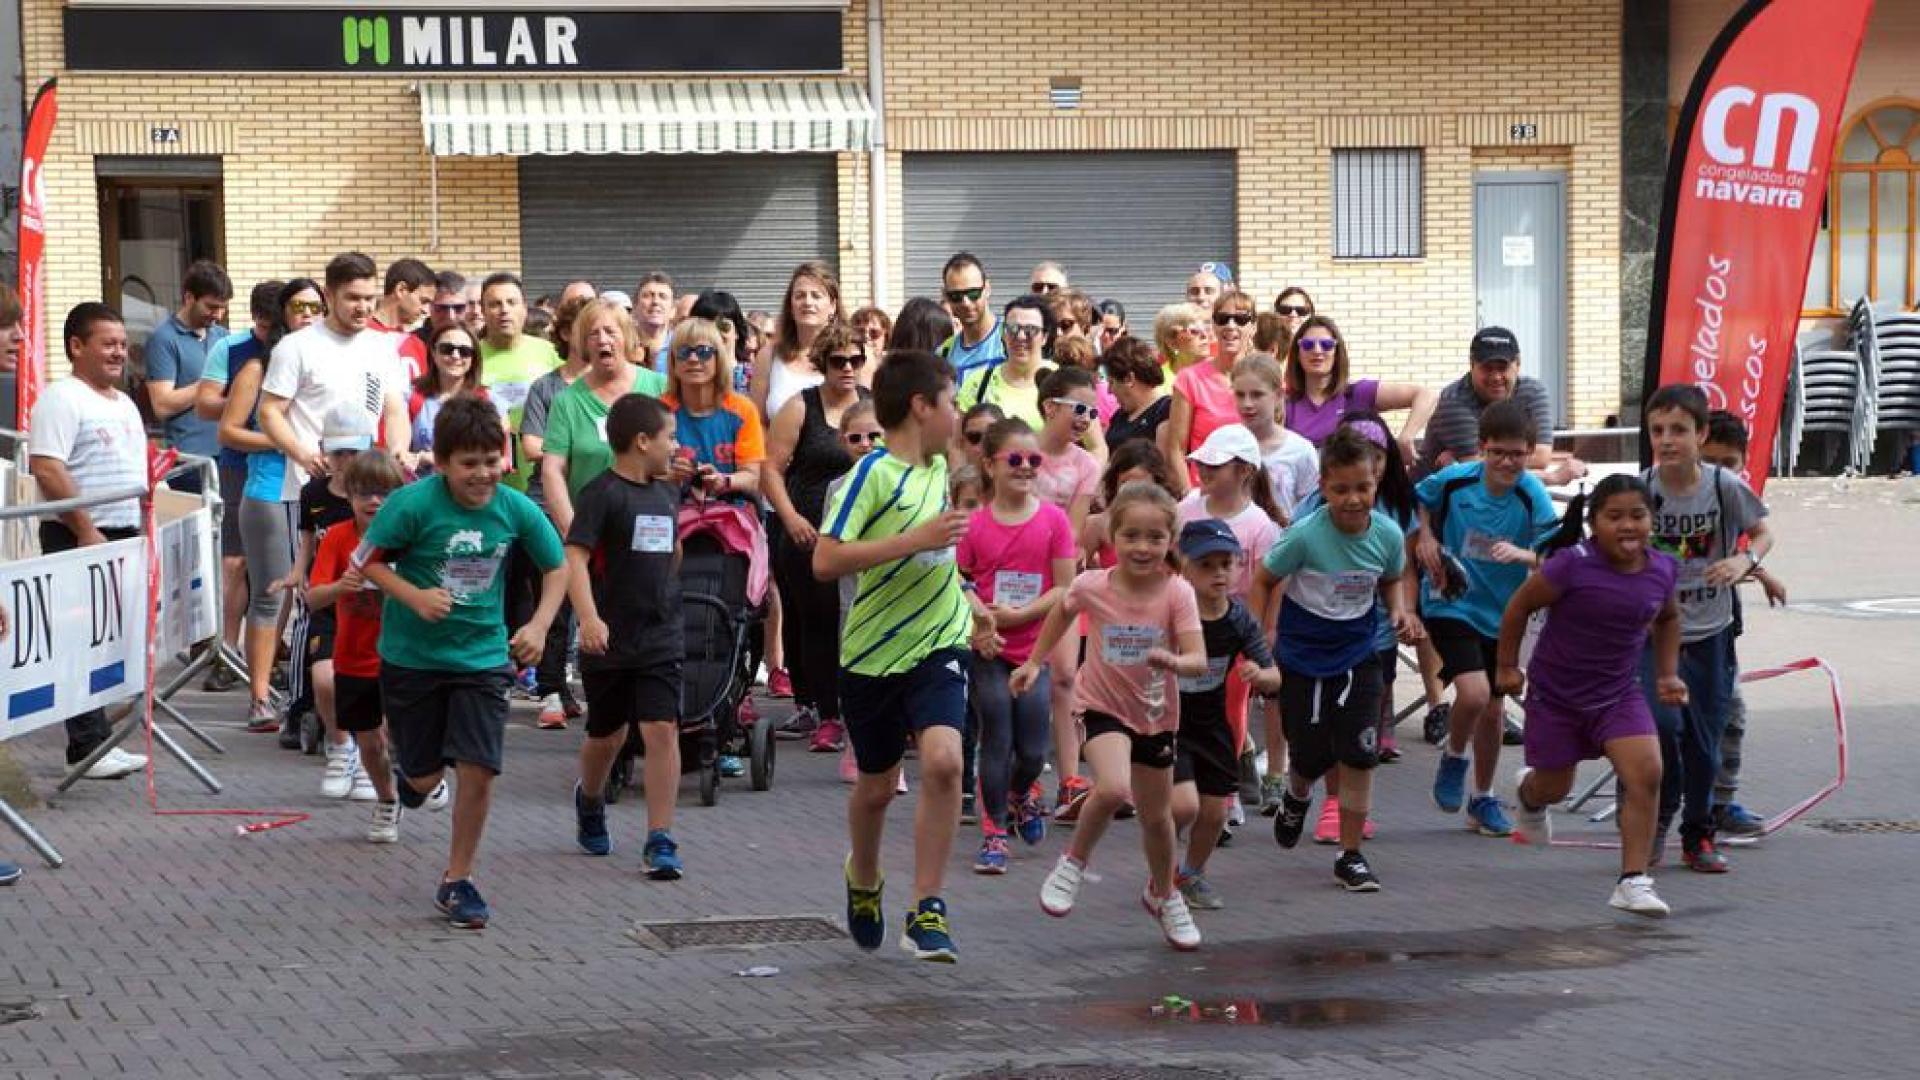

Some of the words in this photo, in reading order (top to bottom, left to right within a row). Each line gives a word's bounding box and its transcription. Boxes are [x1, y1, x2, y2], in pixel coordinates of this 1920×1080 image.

[402, 16, 579, 65] MILAR
[1702, 85, 1820, 174] cn
[1696, 178, 1803, 209] navarra
[1698, 164, 1783, 185] congelados
[1786, 172, 1807, 188] de
[1690, 254, 1731, 411] gelados
[11, 574, 53, 669] DN
[88, 558, 125, 648] DN
